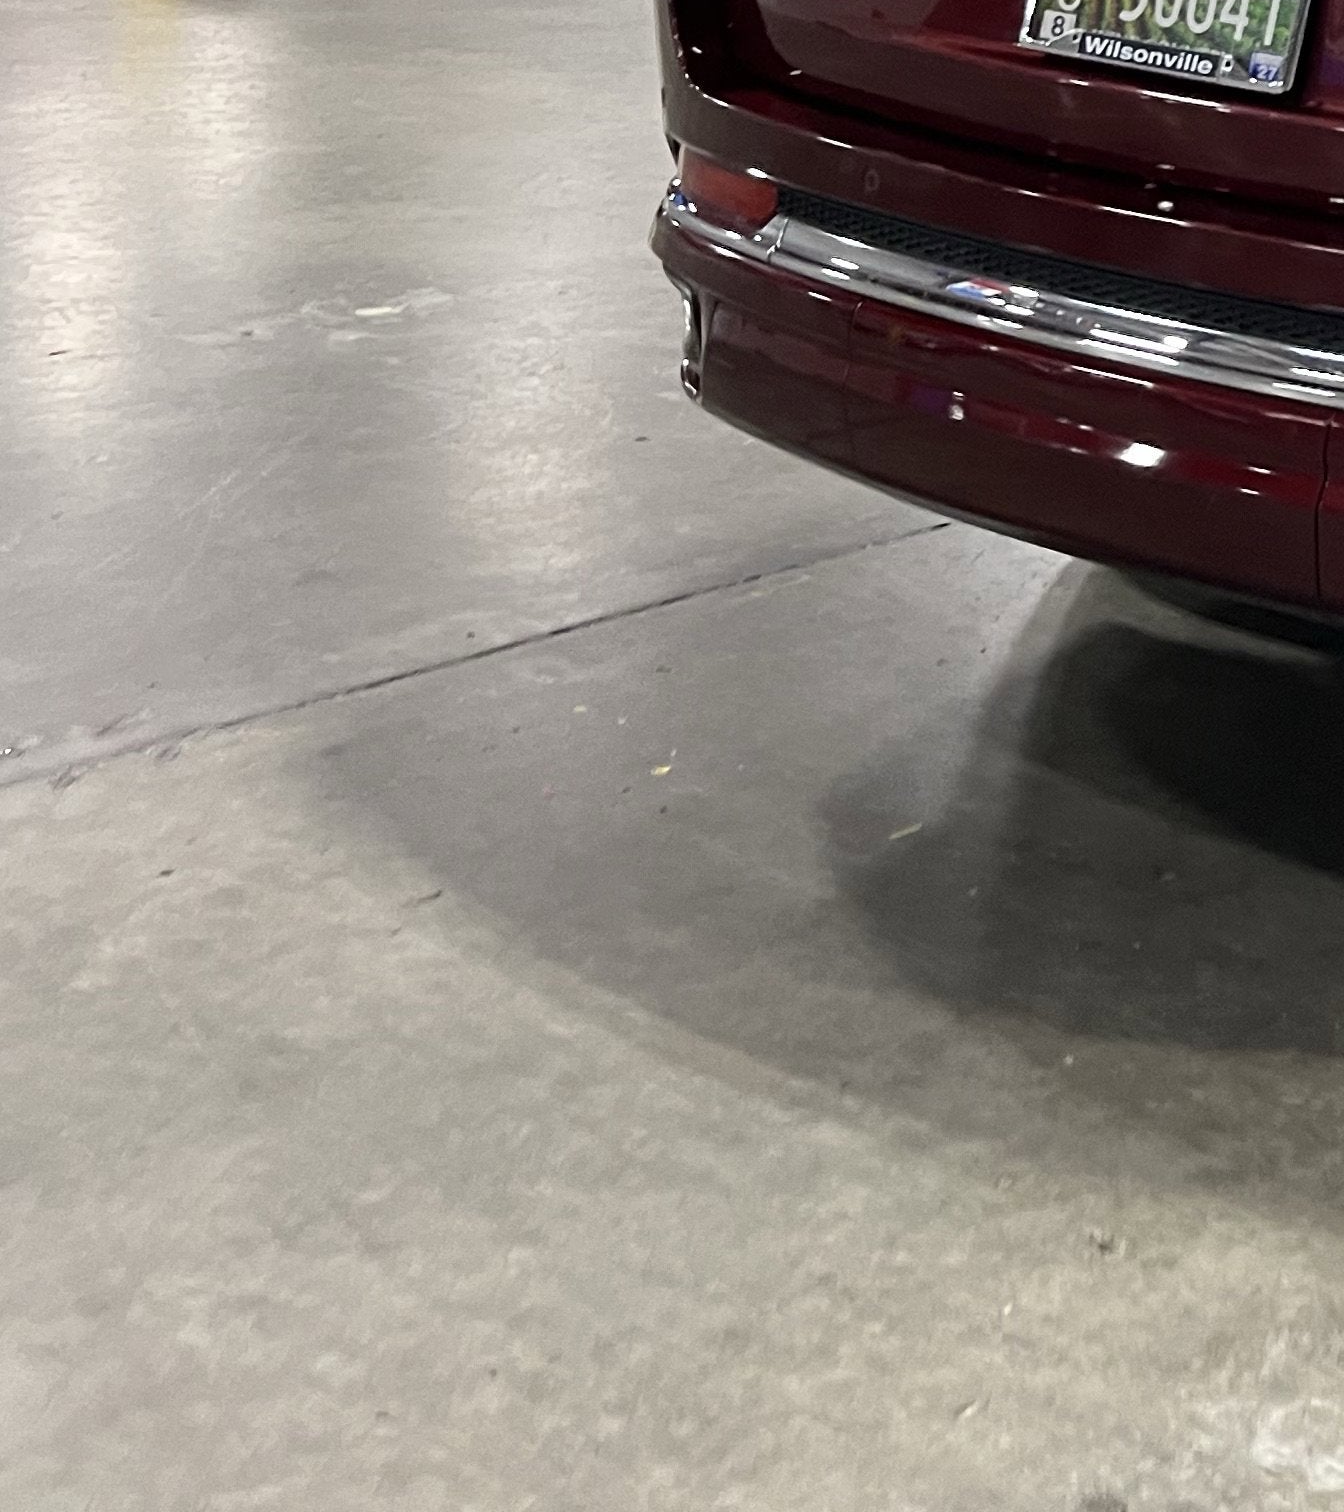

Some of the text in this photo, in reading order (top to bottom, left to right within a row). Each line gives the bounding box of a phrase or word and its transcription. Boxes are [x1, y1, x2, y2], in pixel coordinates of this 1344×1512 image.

[1050, 15, 1066, 36] 8
[1085, 34, 1213, 75] Wilsonville
[1257, 64, 1278, 81] 27
